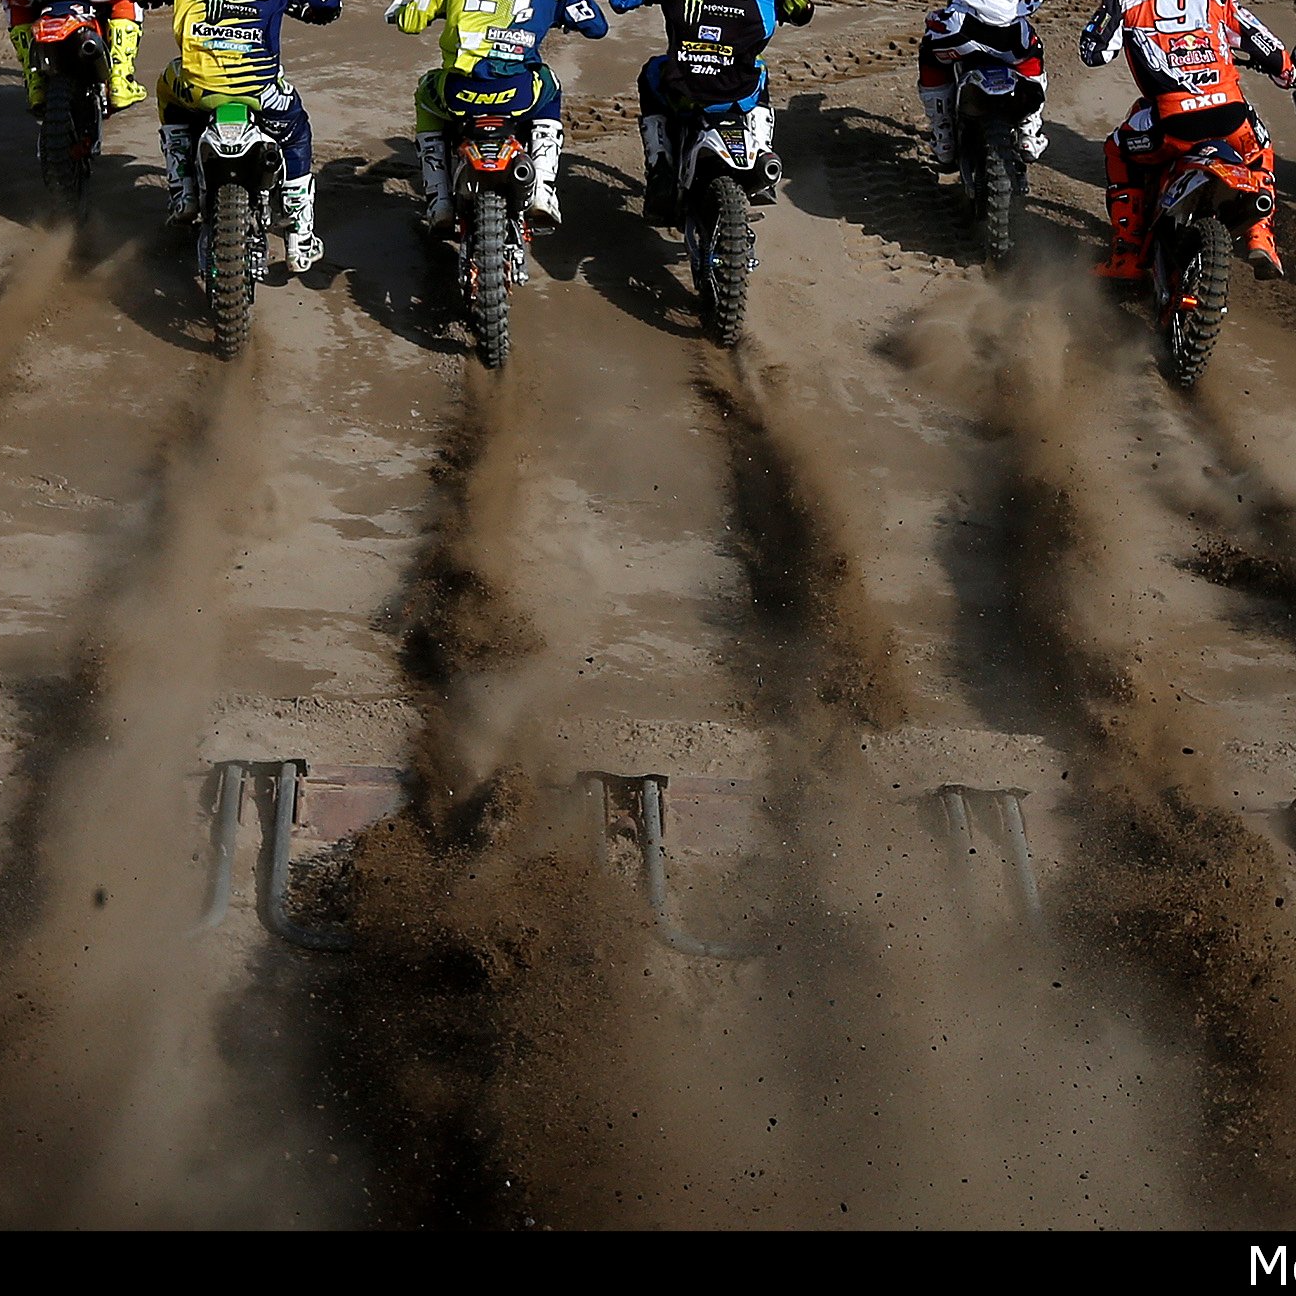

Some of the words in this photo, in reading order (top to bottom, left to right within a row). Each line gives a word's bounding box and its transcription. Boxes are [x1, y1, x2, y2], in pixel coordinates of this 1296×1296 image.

[703, 5, 745, 16] MONSTER
[487, 27, 535, 45] HITACHI
[1168, 53, 1195, 68] Red
[1180, 93, 1227, 111] AXO
